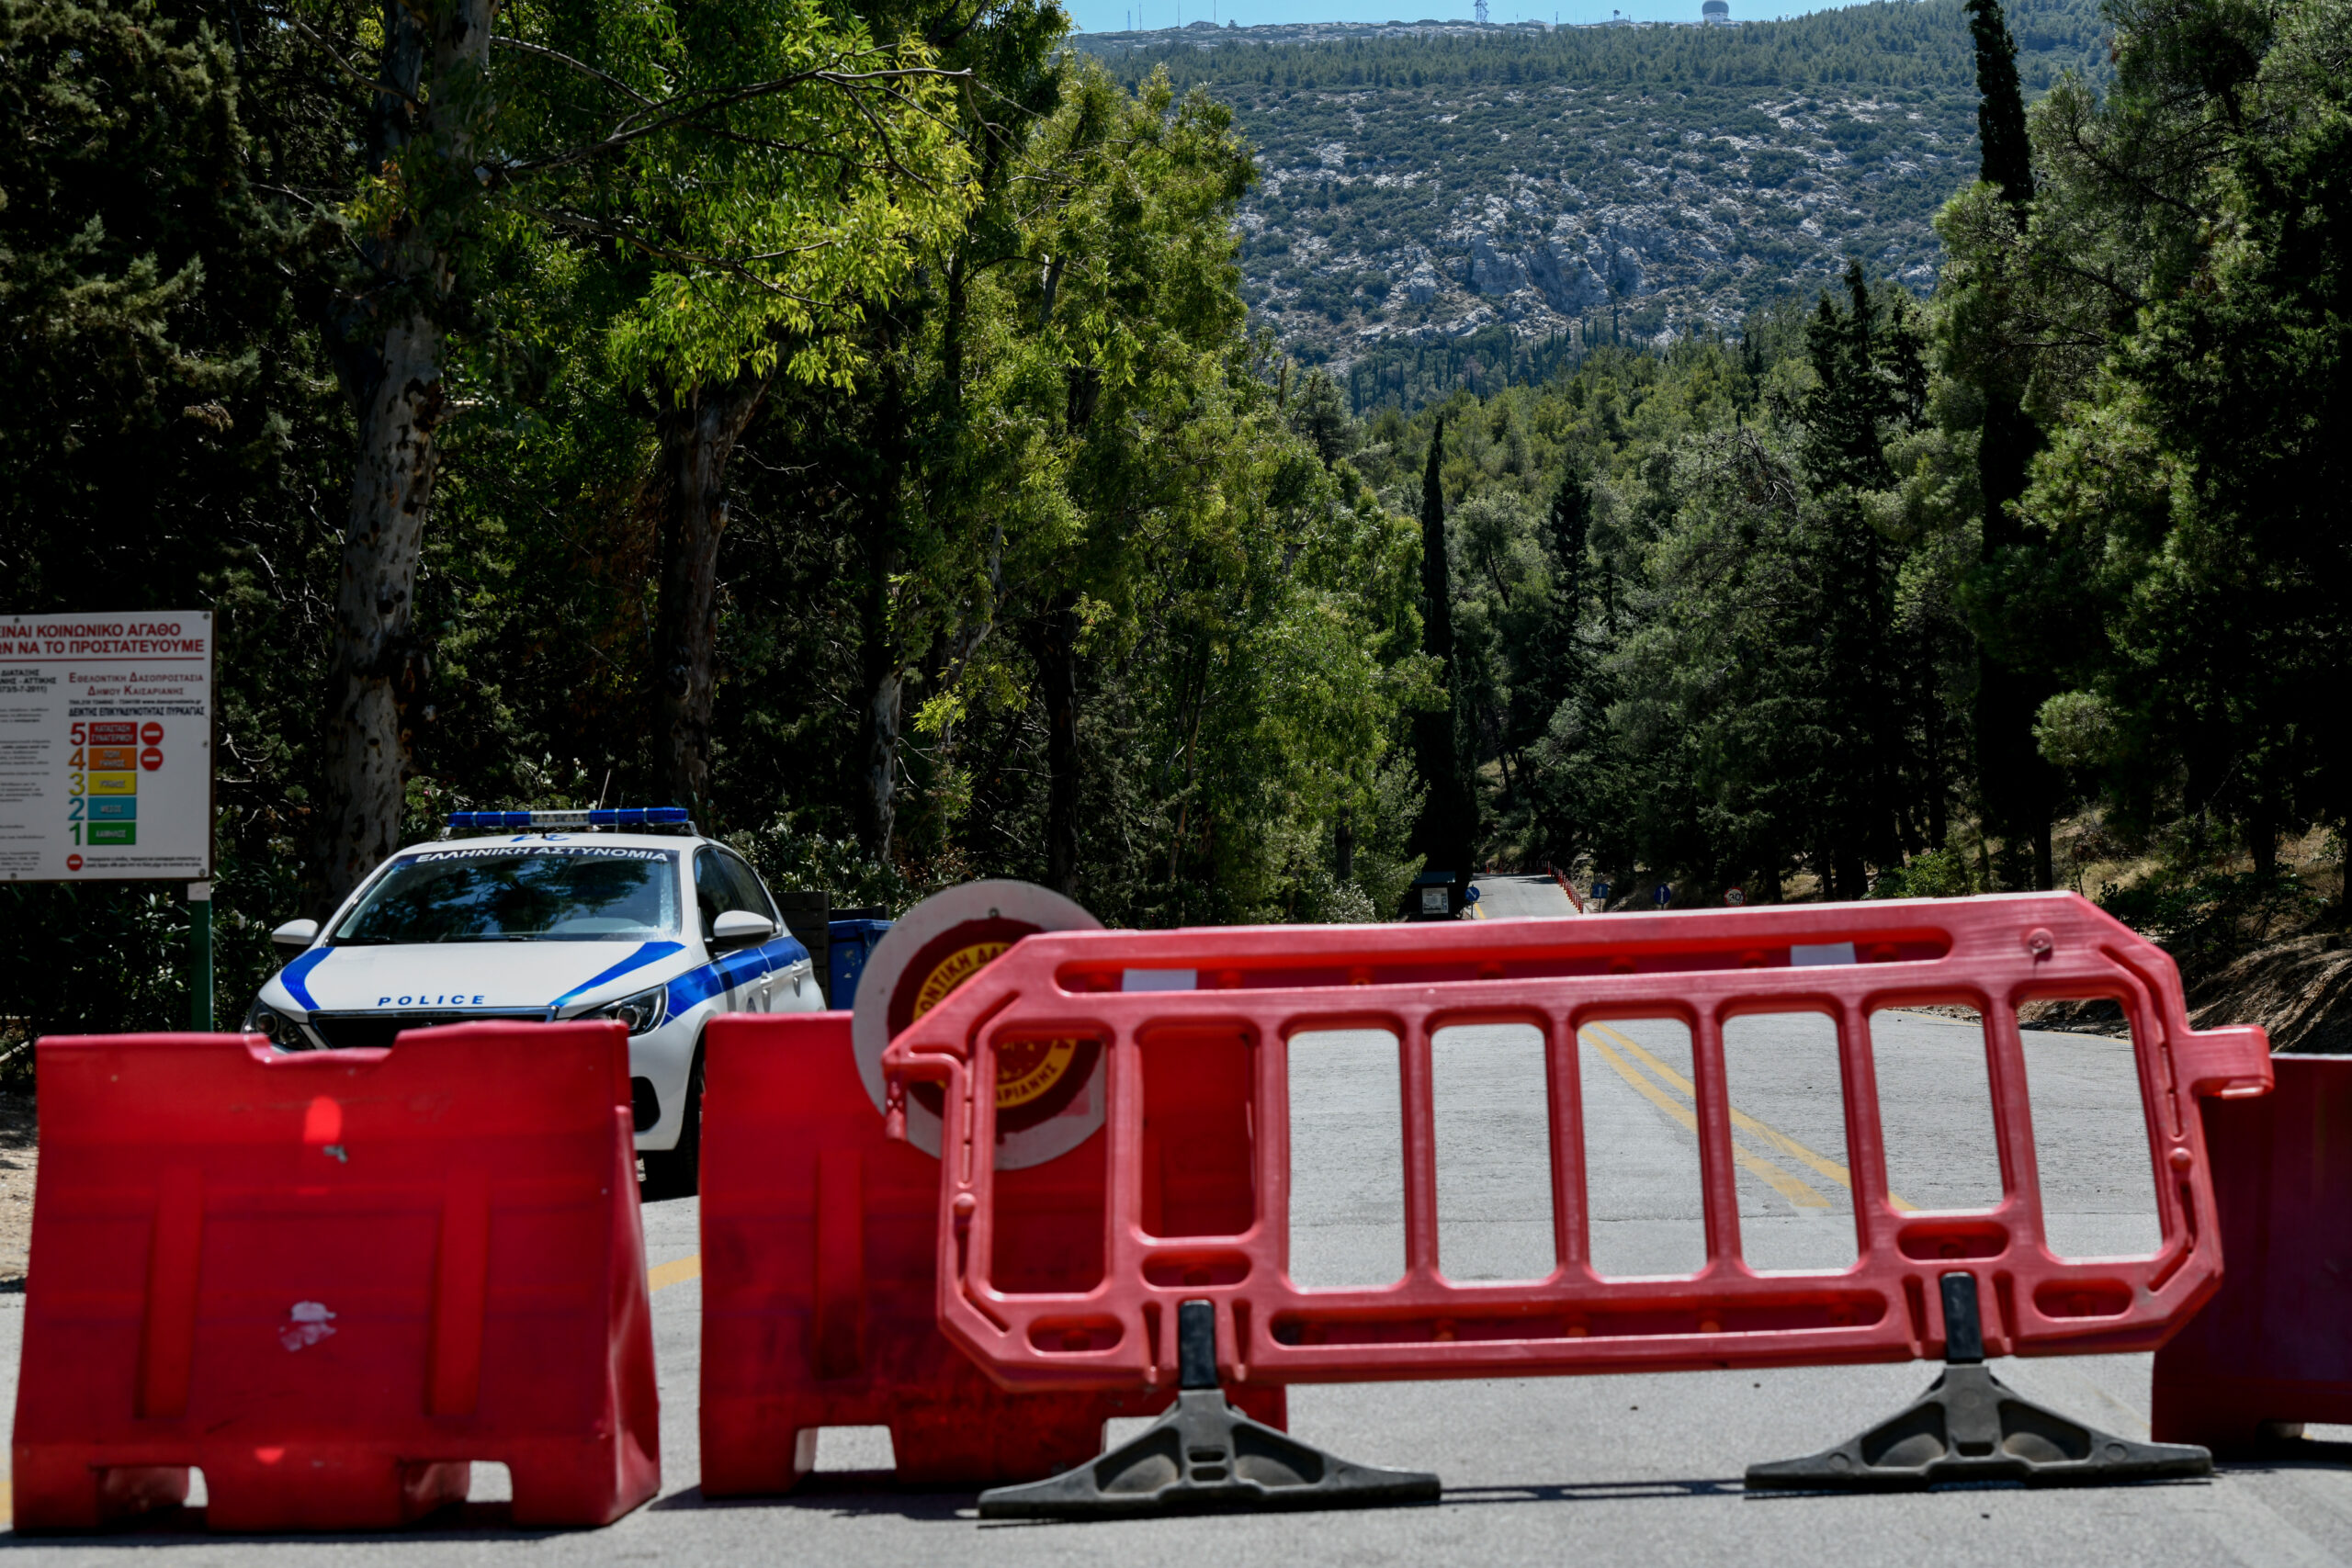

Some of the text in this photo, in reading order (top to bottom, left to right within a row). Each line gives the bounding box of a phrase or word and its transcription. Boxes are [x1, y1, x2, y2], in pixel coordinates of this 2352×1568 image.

[37, 624, 124, 637] ΚΟΙΝΩΝΙΚΟ
[128, 623, 182, 637] ΑΓΑΘΟ
[17, 641, 40, 654] ΝΑ
[44, 641, 65, 654] ΤΟ
[70, 639, 205, 653] ΠΡΟΣΤΑΤΕΥΟΥΜΕ
[70, 722, 86, 746] 5
[68, 747, 86, 771] 4
[69, 773, 85, 796] 3
[68, 797, 85, 820] 2
[69, 822, 81, 846] 1
[415, 846, 669, 863] ΕΛΛΗΝΙΚΗ ΑΣΤΥΝΟΜΙΑ
[920, 953, 972, 1011] ΟΝΤΙΚΗ
[378, 995, 485, 1007] POLICE
